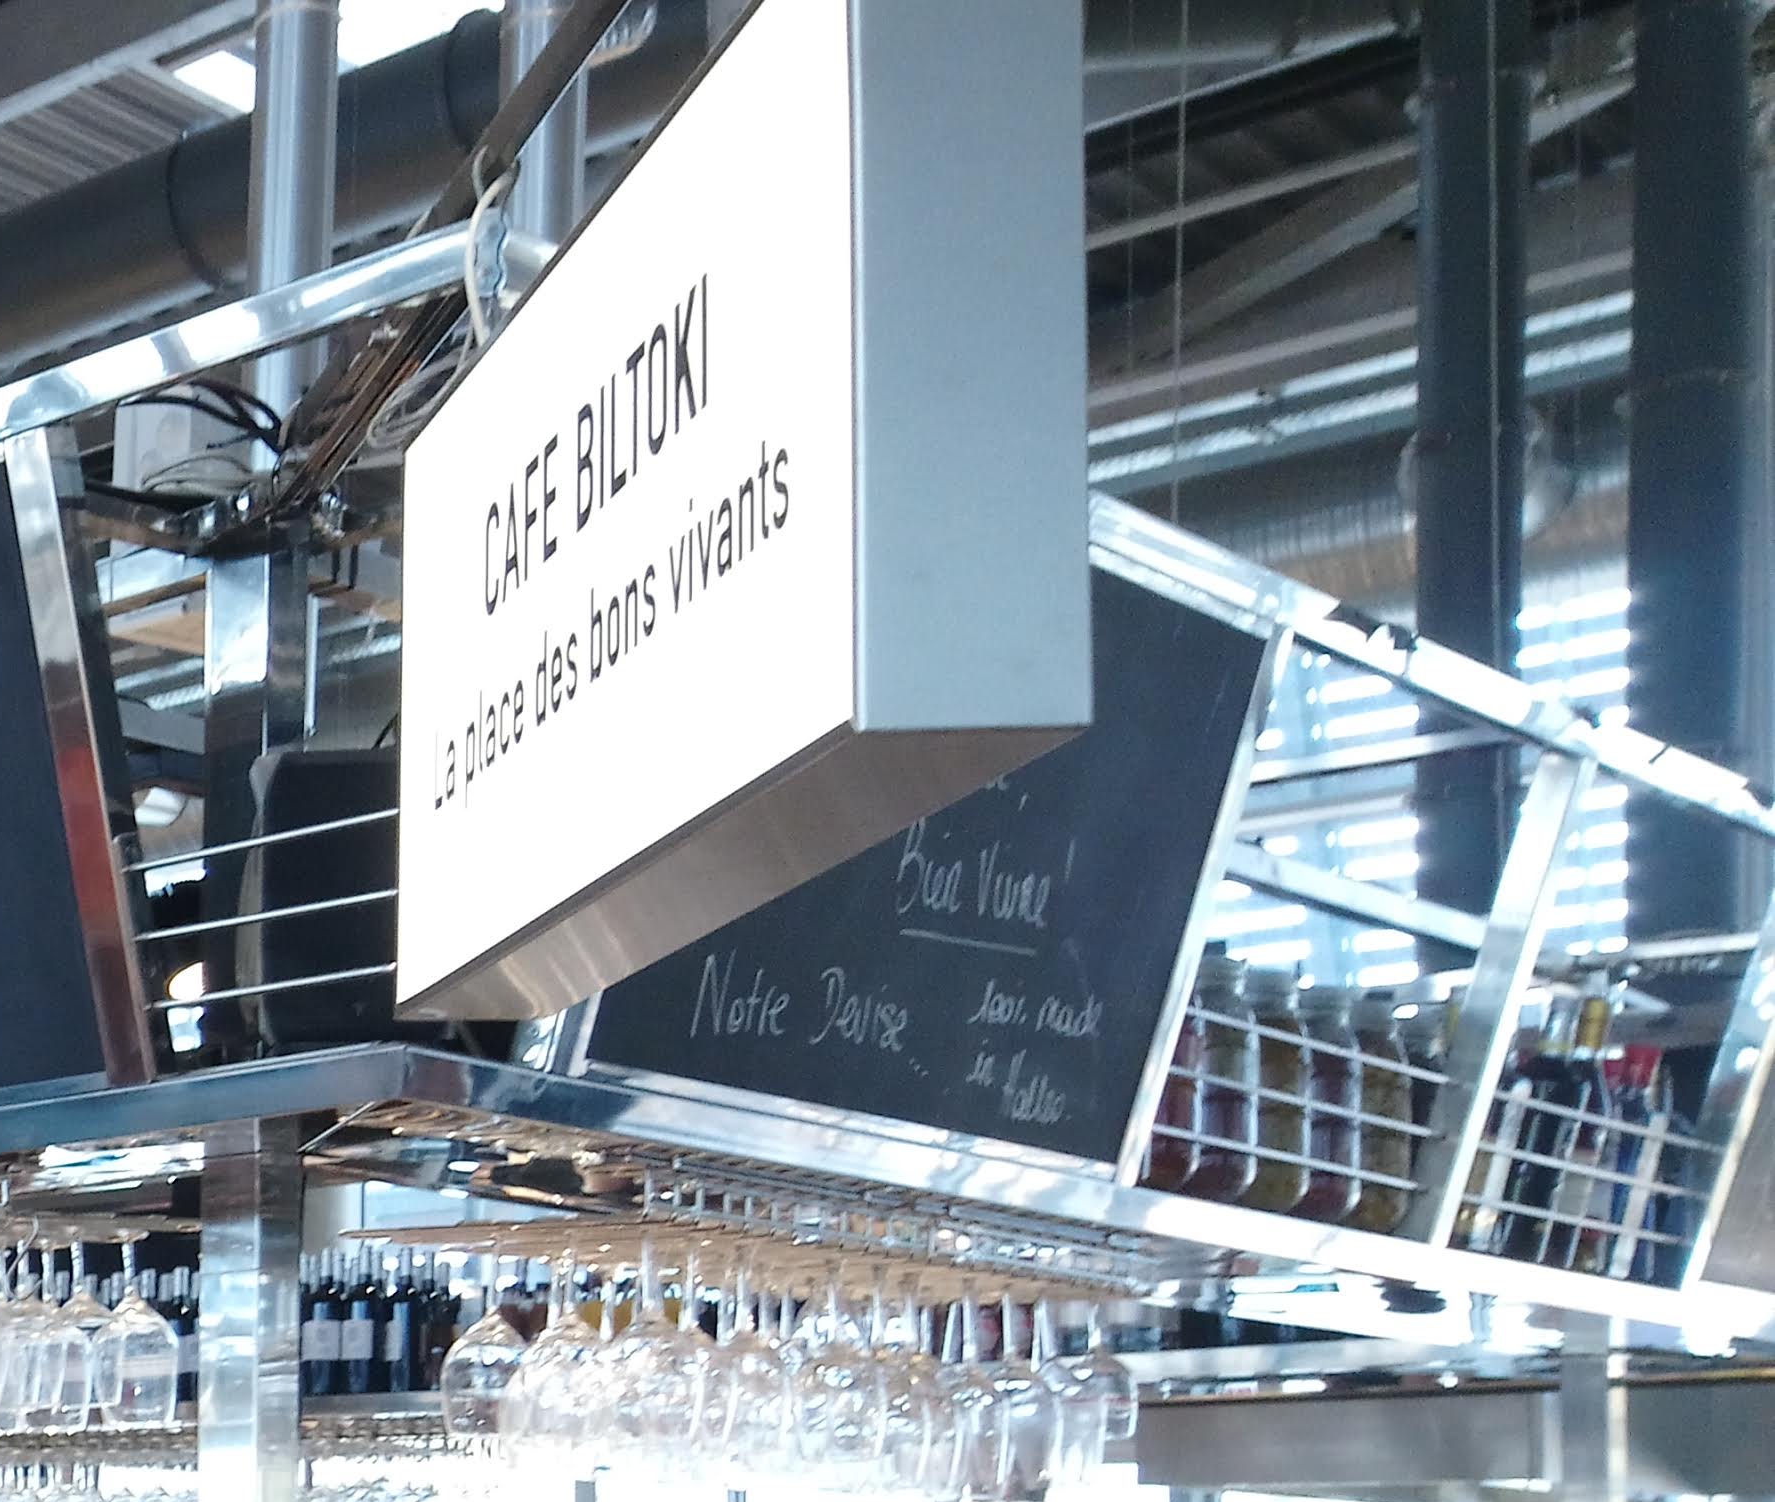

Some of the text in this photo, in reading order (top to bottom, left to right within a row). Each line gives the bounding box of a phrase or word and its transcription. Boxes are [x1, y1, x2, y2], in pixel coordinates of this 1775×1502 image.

[484, 273, 708, 616] CAFE BILTOKI
[465, 680, 525, 809] place
[535, 630, 577, 727] des
[589, 563, 656, 683] bons
[669, 440, 789, 613] vivants
[689, 948, 791, 1039] Notre
